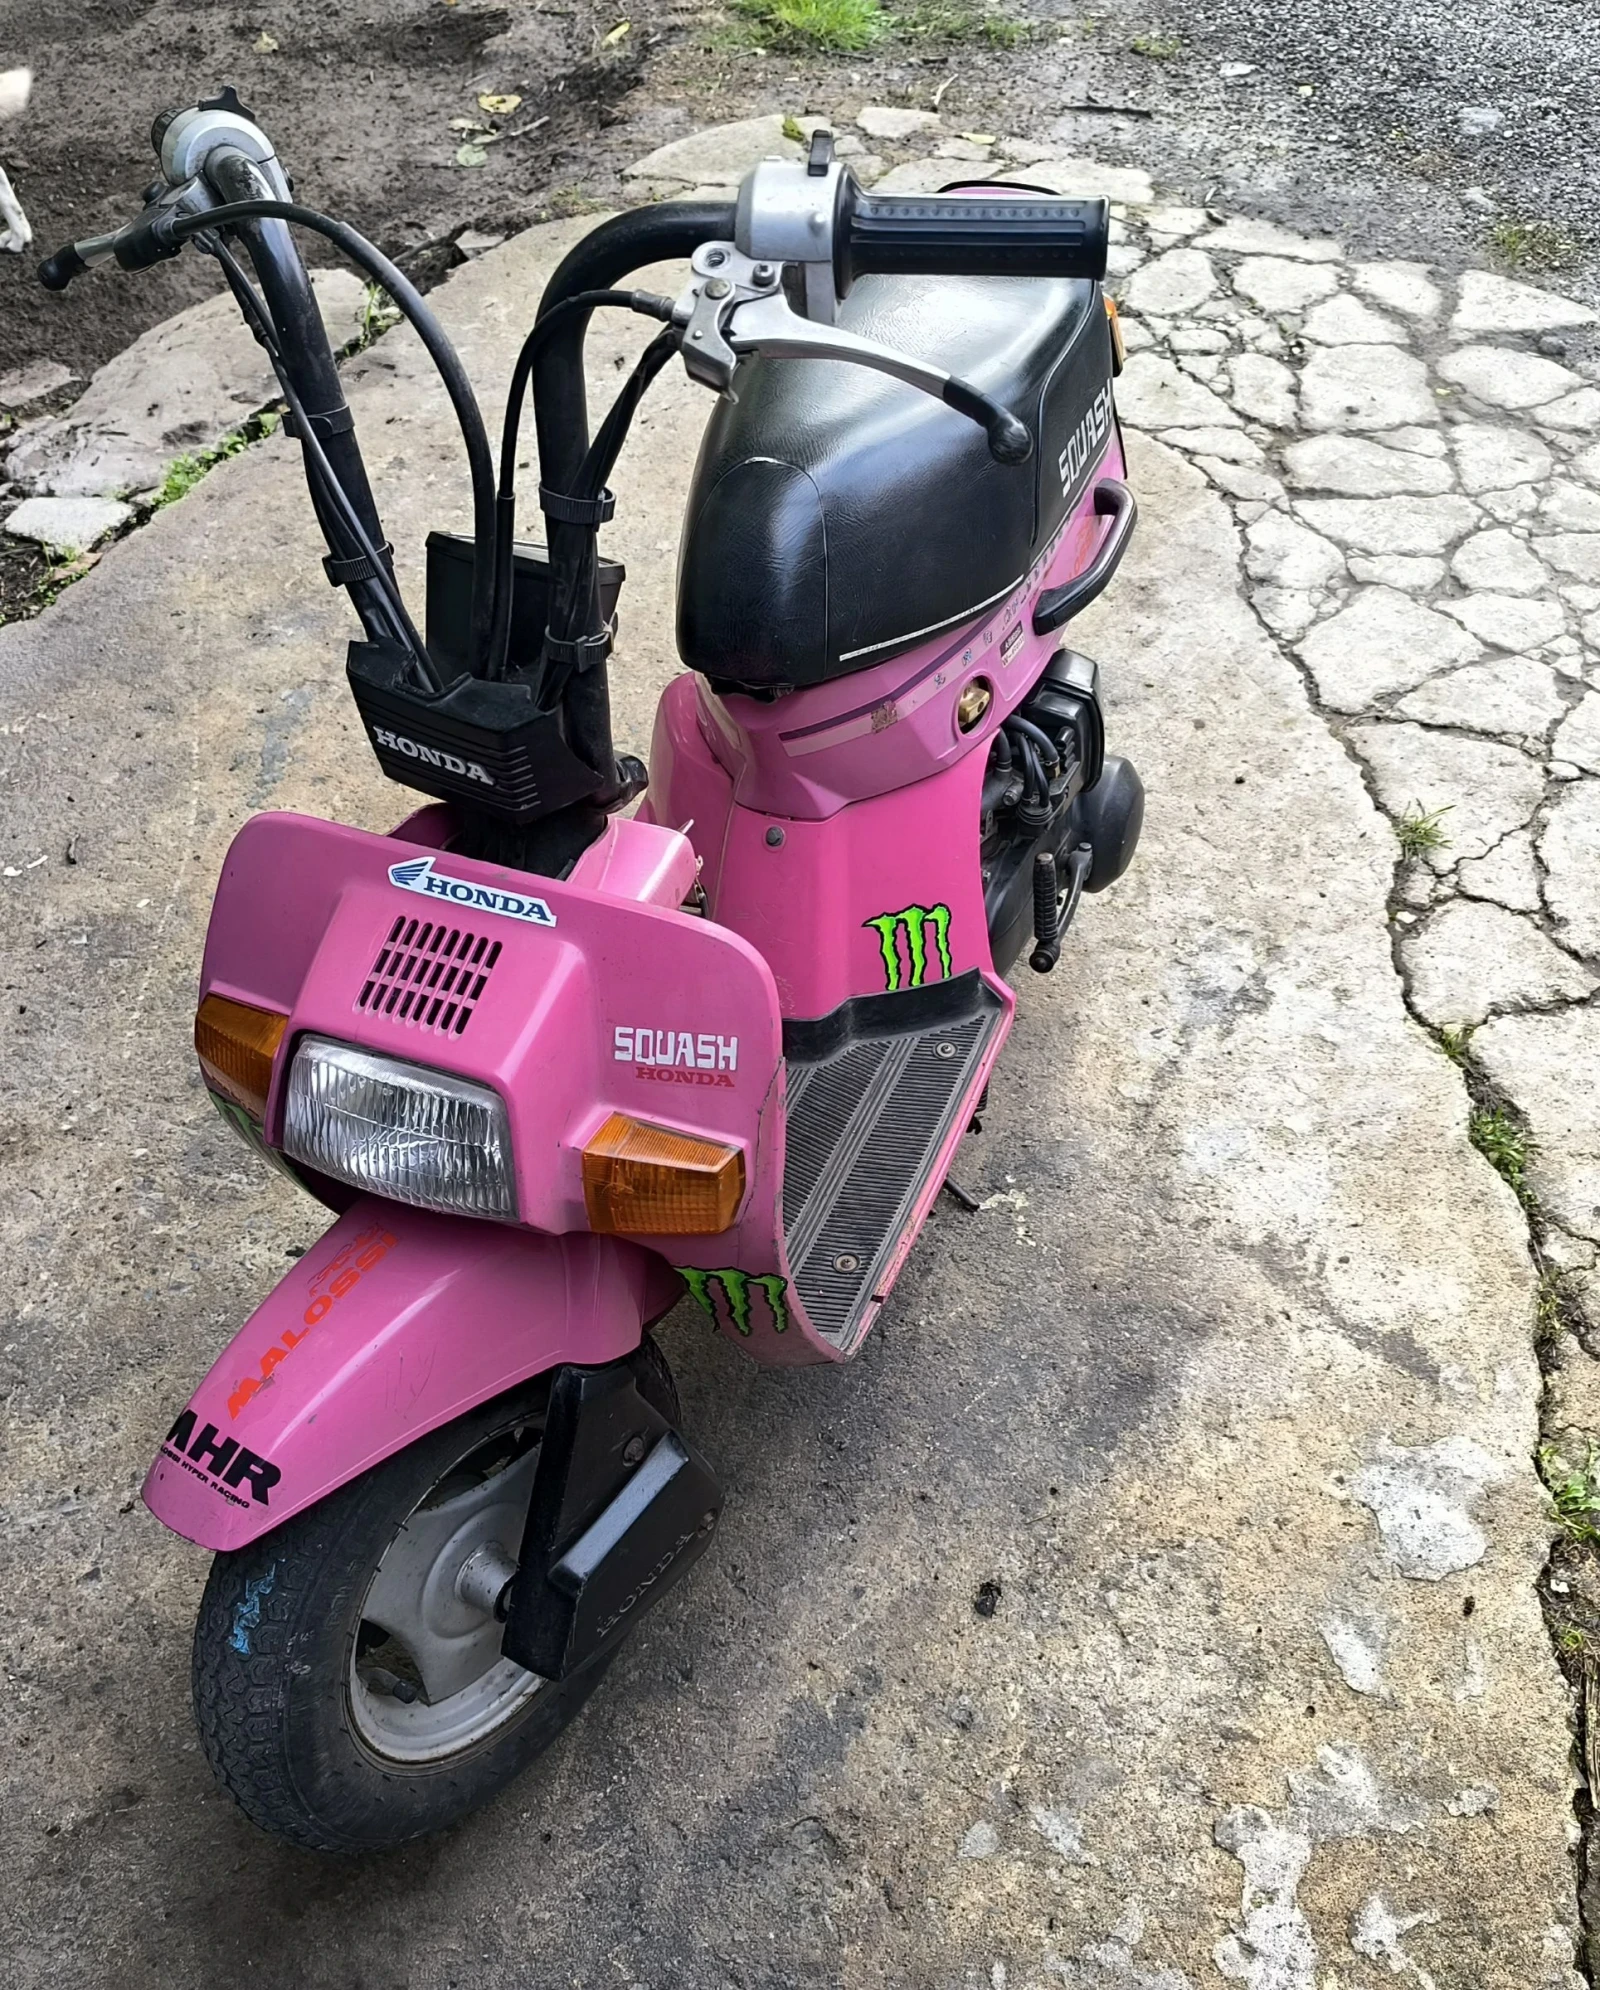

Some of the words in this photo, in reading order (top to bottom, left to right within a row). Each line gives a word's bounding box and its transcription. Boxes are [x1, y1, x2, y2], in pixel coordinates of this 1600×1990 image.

[1058, 377, 1113, 498] SQUASH
[372, 724, 496, 786] HONDA
[423, 876, 551, 922] HONDA
[613, 1026, 739, 1072] SQUASH
[635, 1066, 735, 1088] HONDA
[226, 1231, 398, 1421] MALOSSI
[181, 1460, 209, 1483] HYPER
[210, 1481, 251, 1509] RACING
[596, 1531, 696, 1637] HONDA
